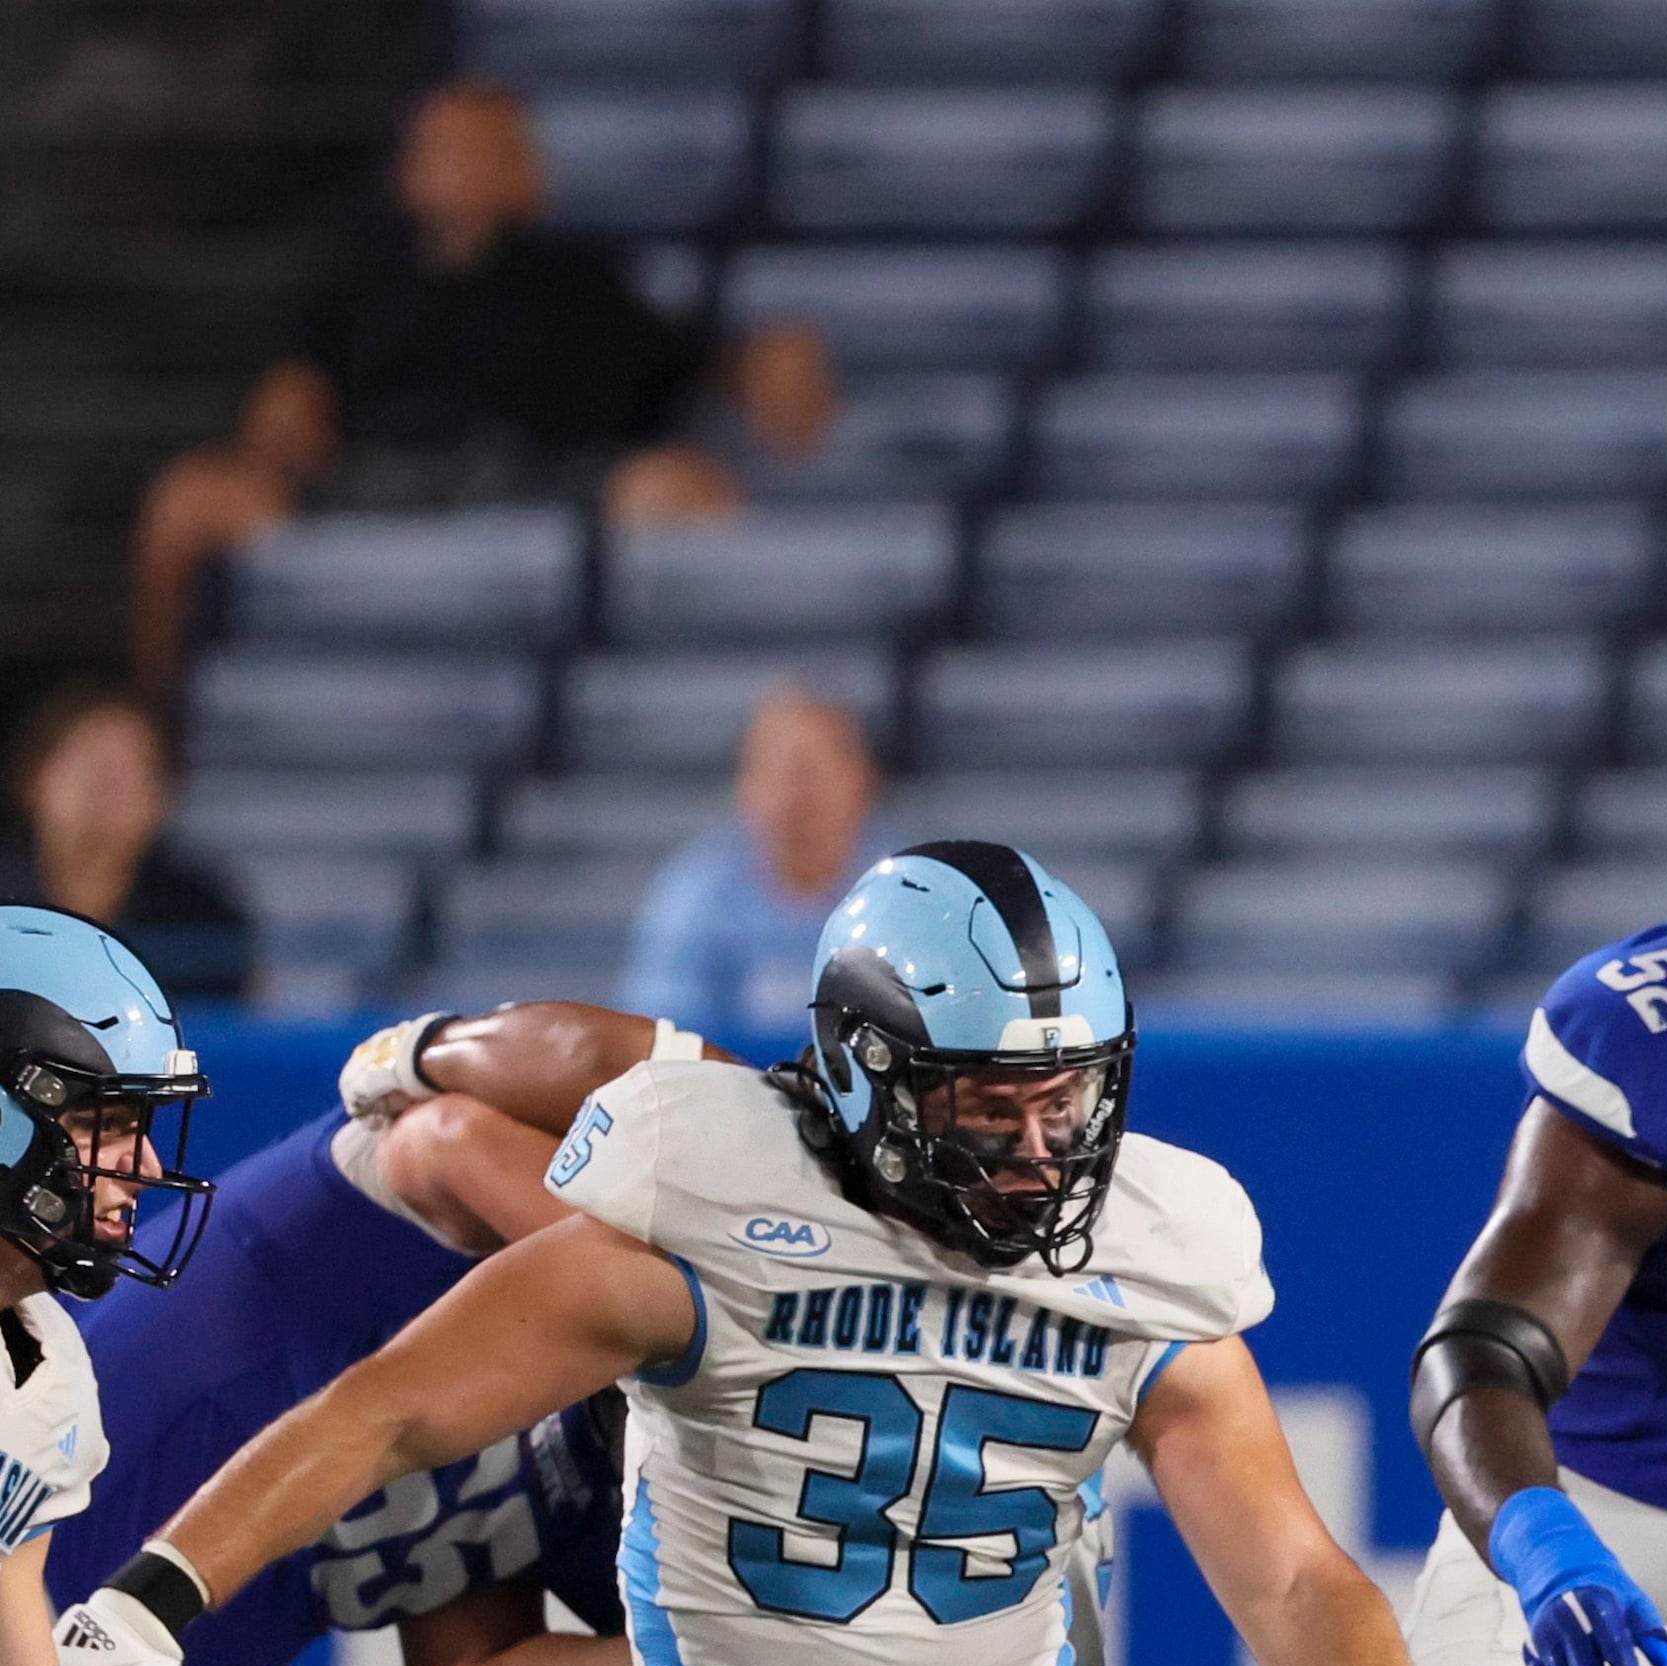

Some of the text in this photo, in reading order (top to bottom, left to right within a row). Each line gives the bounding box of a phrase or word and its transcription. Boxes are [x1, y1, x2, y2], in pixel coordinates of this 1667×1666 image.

[745, 1217, 817, 1247] CAA
[763, 1281, 1111, 1379] RHODE ISLAND
[727, 1366, 1102, 1625] 35
